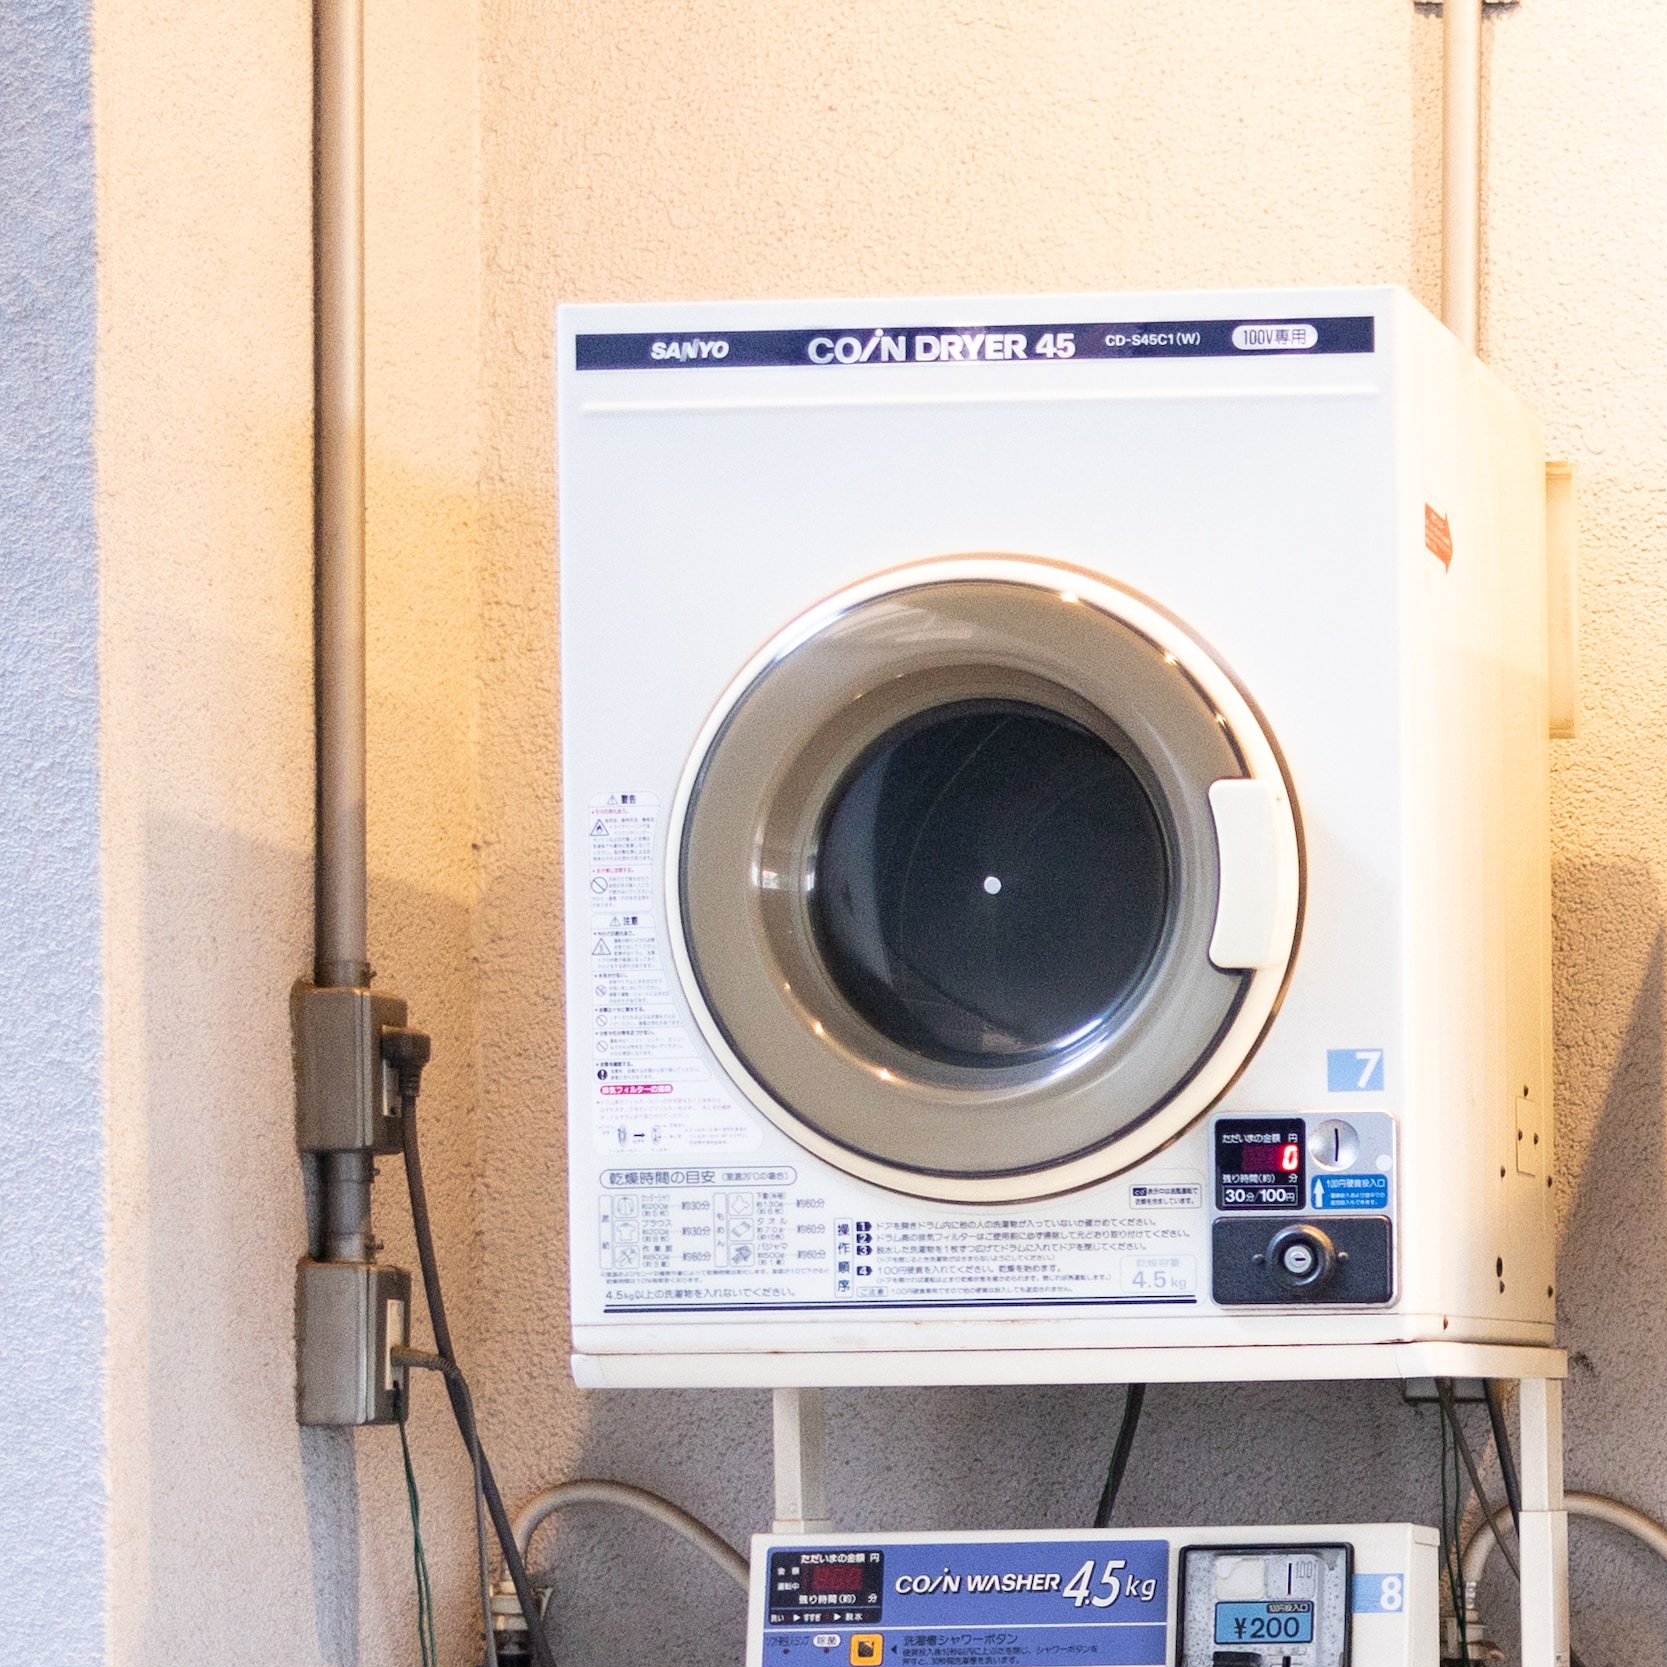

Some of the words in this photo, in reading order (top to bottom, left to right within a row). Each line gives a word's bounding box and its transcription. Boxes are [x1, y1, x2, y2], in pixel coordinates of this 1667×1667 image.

[651, 339, 729, 361] SANYO
[807, 328, 906, 364] COIN
[914, 334, 1027, 361] DRYER
[1035, 331, 1077, 359] 45
[1105, 332, 1200, 346] CD-S45C1(W)
[1242, 328, 1308, 345] 100V専用
[1356, 1051, 1382, 1089] 7
[1282, 1145, 1299, 1171] 0
[609, 1171, 716, 1185] 乾燥時間の目安
[1133, 1270, 1168, 1289] 4.5
[1171, 1278, 1187, 1289] kg
[801, 1553, 865, 1564] ただいまの金額
[870, 1553, 879, 1562] 円
[895, 1567, 961, 1594] COIN
[967, 1573, 1064, 1594] WASHER
[1062, 1560, 1128, 1609] 4.5
[1125, 1574, 1157, 1601] kg
[1380, 1576, 1401, 1610] 8
[868, 1594, 877, 1603] 分
[1234, 1617, 1300, 1639] ¥200
